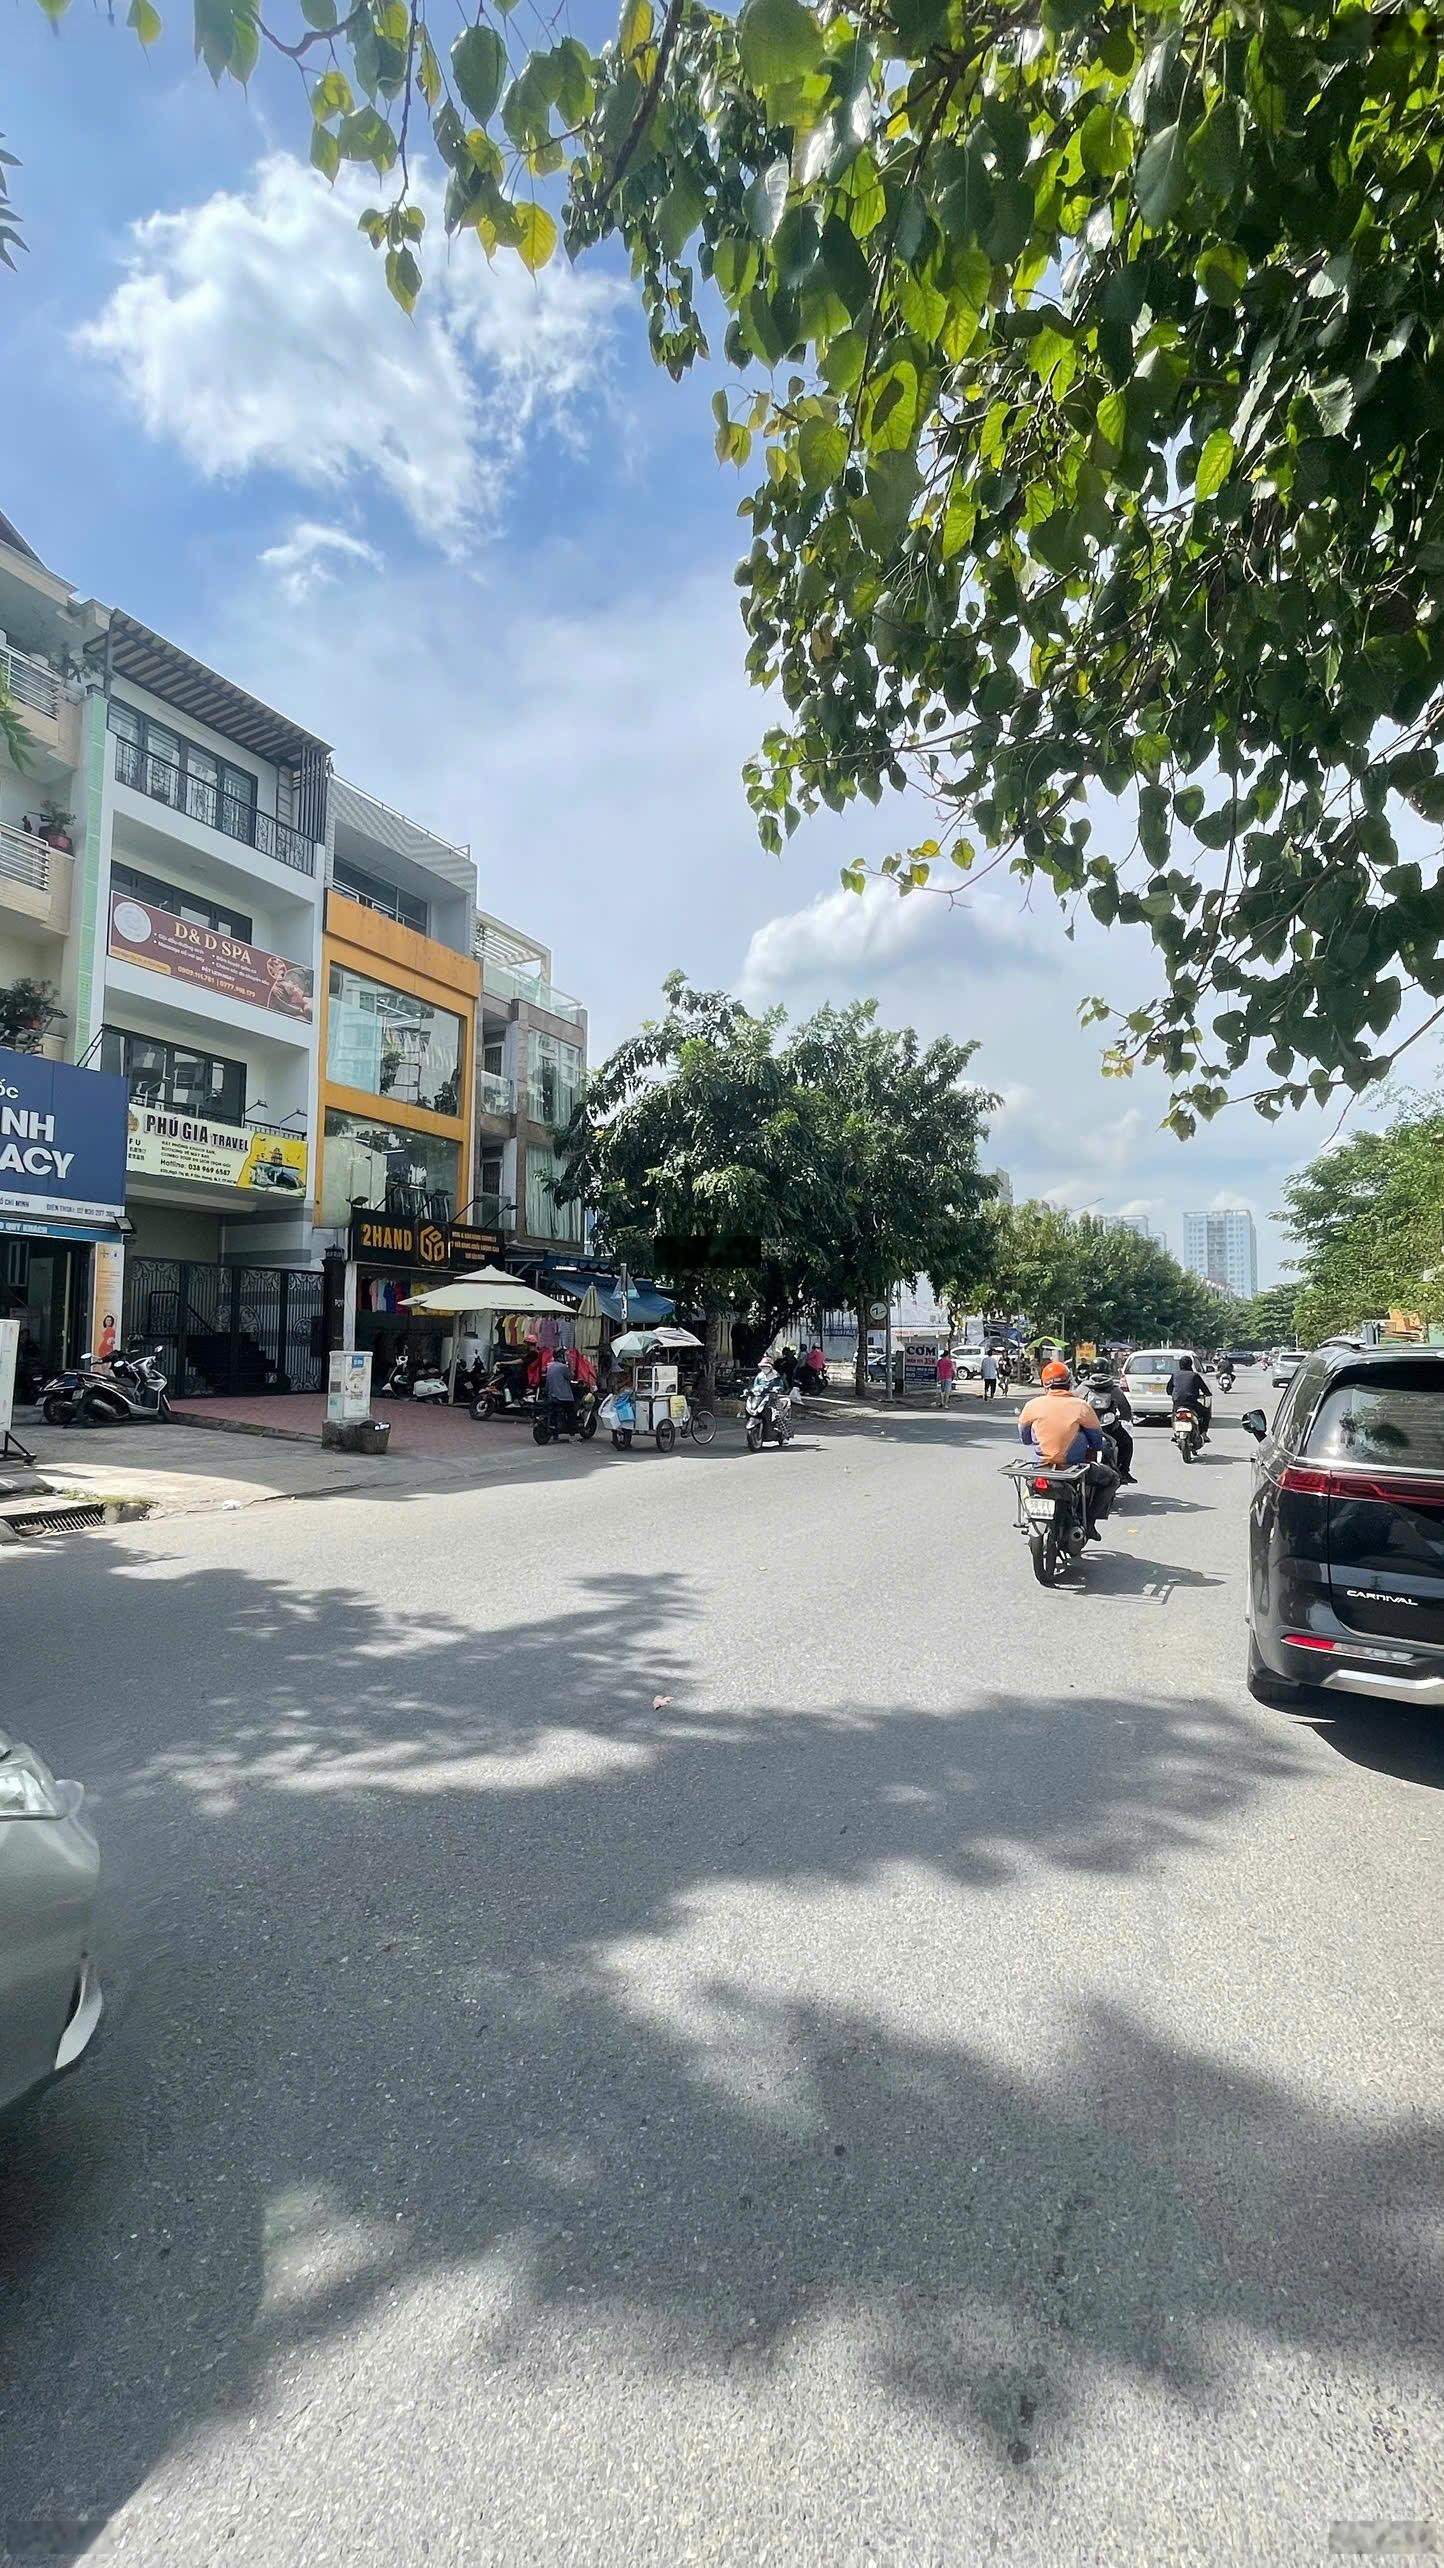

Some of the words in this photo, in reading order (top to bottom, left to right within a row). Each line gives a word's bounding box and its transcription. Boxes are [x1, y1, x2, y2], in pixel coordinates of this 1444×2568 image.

[221, 941, 252, 965] SPA
[146, 1114, 179, 1137] PHÚ
[182, 1122, 208, 1143] GIA
[212, 1133, 249, 1151] TRAVEL
[362, 1223, 412, 1251] 2HAND
[1346, 1589, 1419, 1606] CARNIVAL
